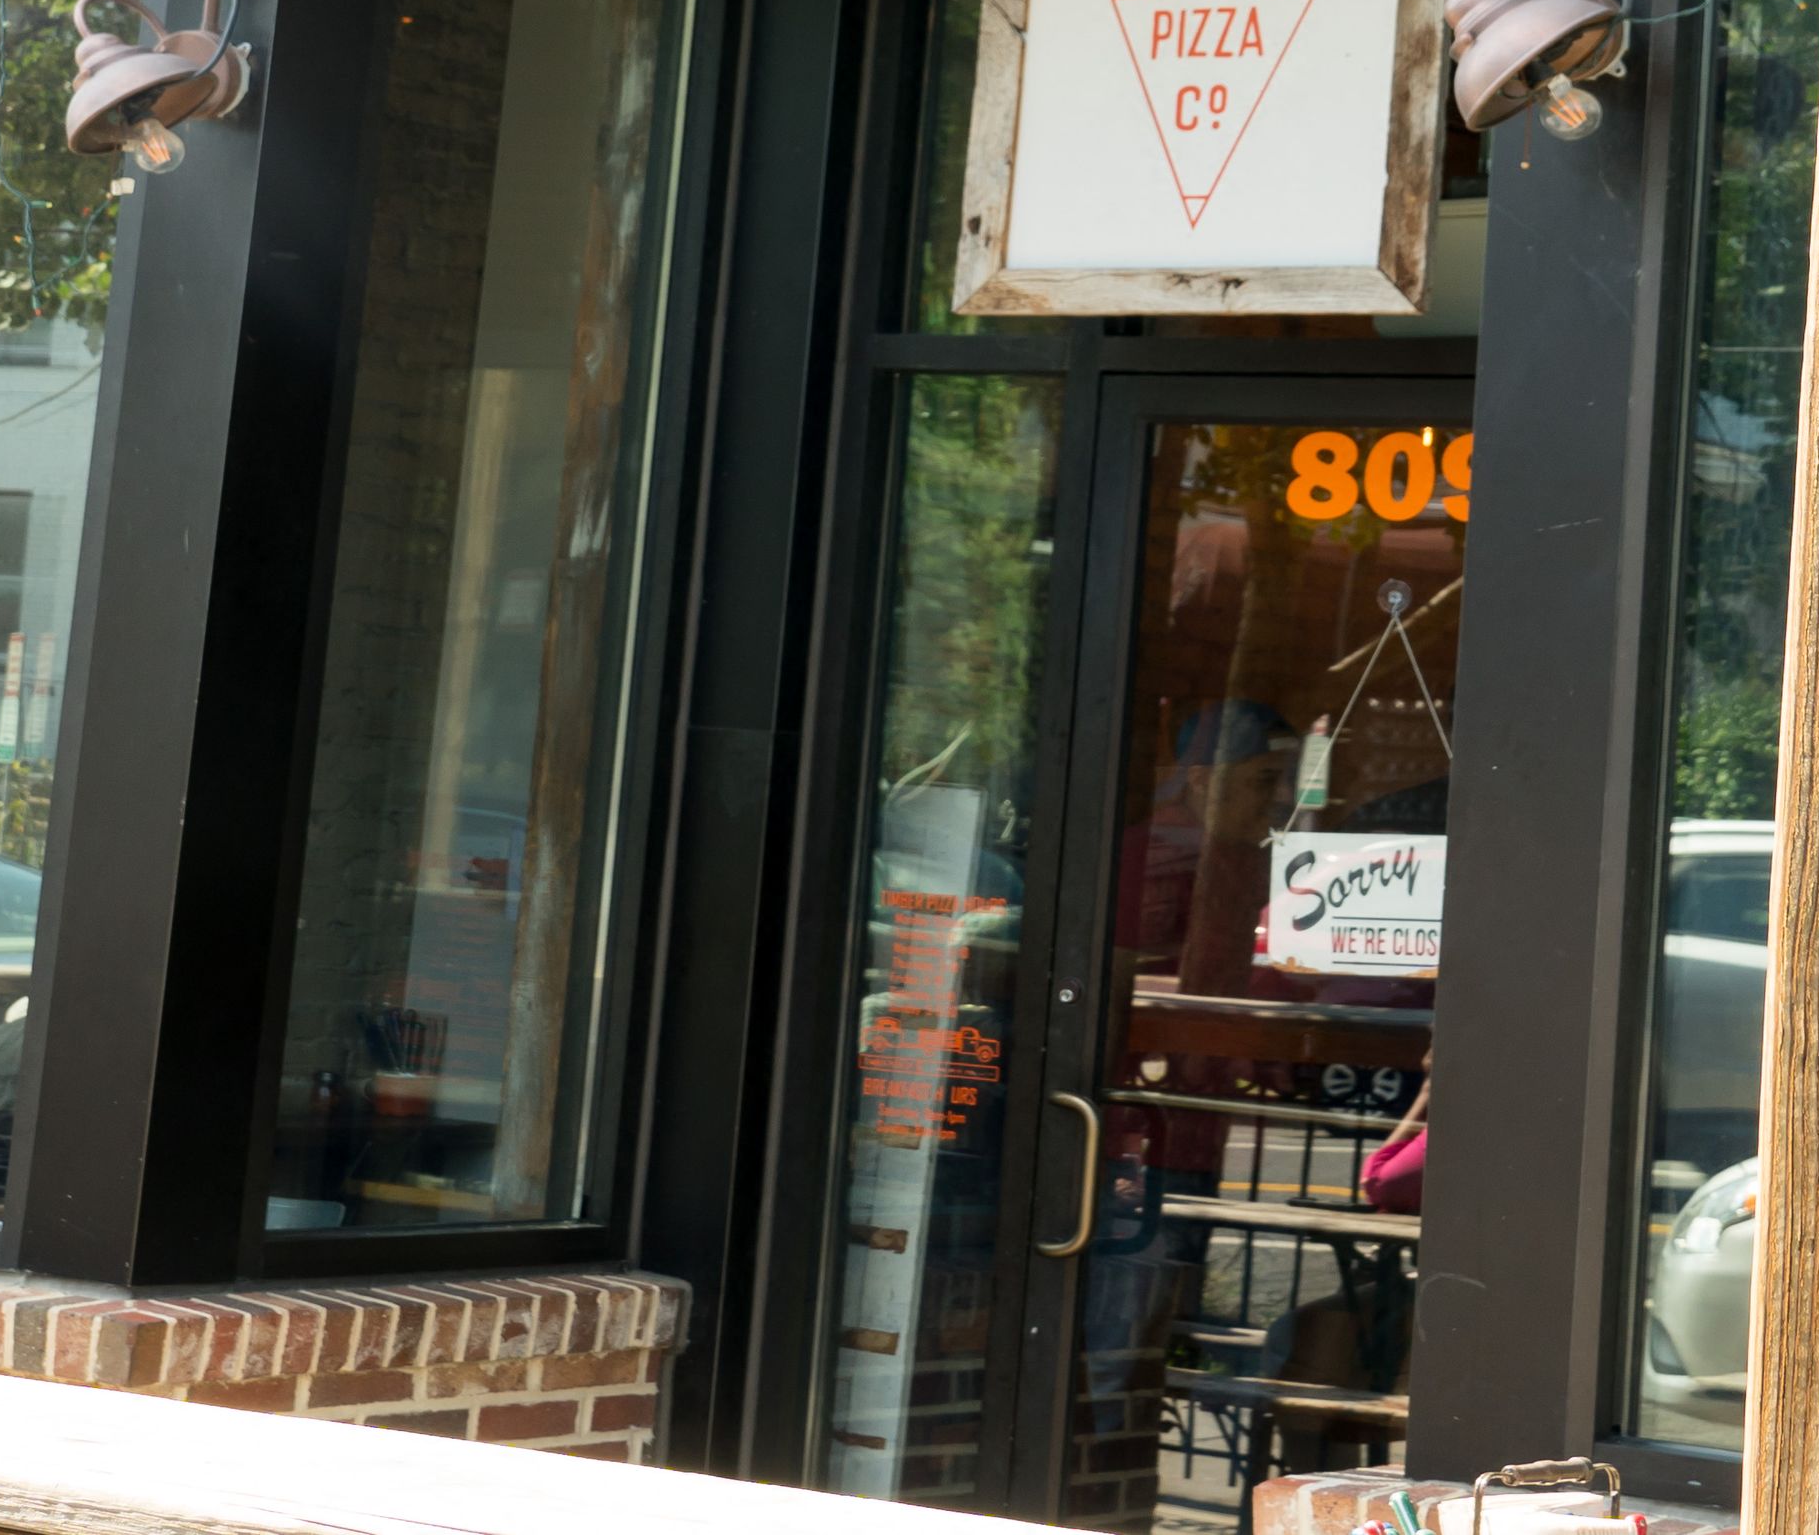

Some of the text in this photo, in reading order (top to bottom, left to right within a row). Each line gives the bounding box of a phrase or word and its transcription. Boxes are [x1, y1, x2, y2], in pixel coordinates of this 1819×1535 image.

[1150, 6, 1263, 60] PIZZA
[1285, 846, 1421, 932] Sorry
[1331, 926, 1387, 955] WE'RE
[934, 1085, 978, 1106] HURS
